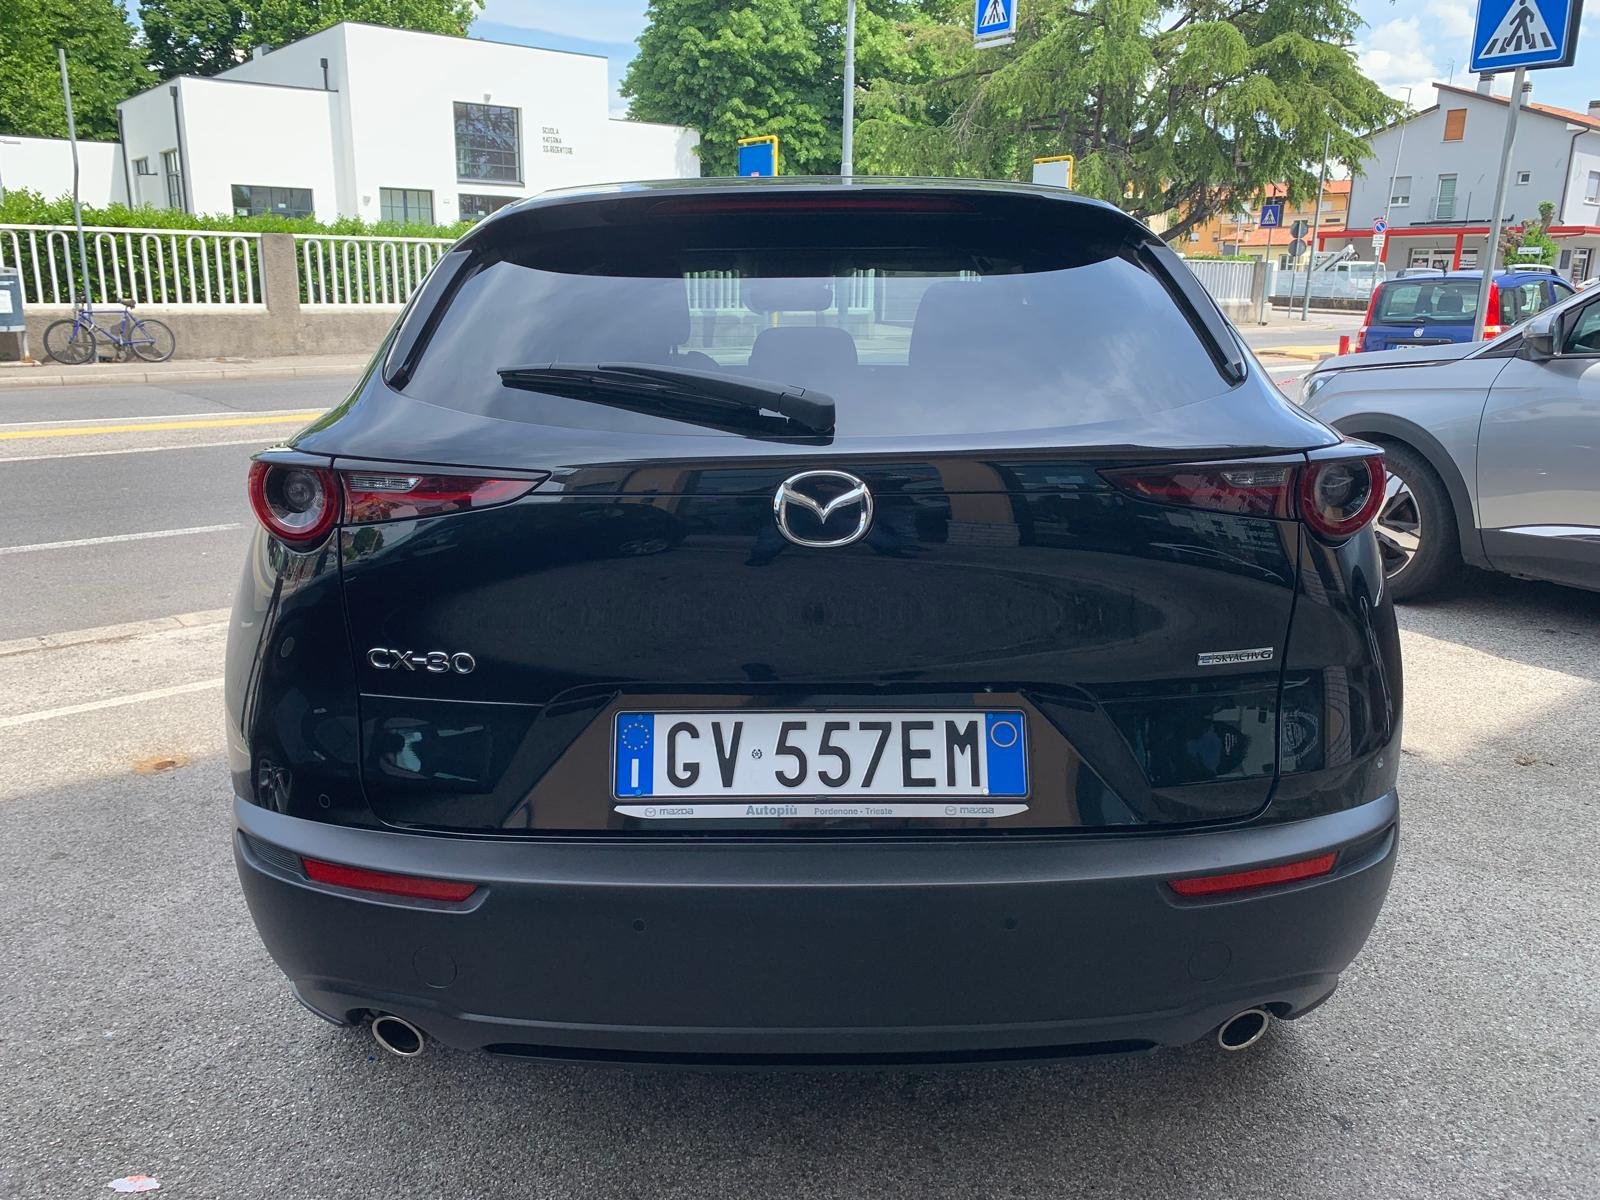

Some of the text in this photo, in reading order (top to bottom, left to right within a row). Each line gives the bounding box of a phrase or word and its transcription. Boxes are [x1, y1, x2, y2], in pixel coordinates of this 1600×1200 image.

[366, 647, 476, 675] CX-30
[666, 720, 981, 789] GV 557EM
[659, 807, 694, 816] mazda
[745, 804, 798, 817] Autopiù
[814, 807, 858, 816] Pordenone
[959, 806, 995, 815] mazda
